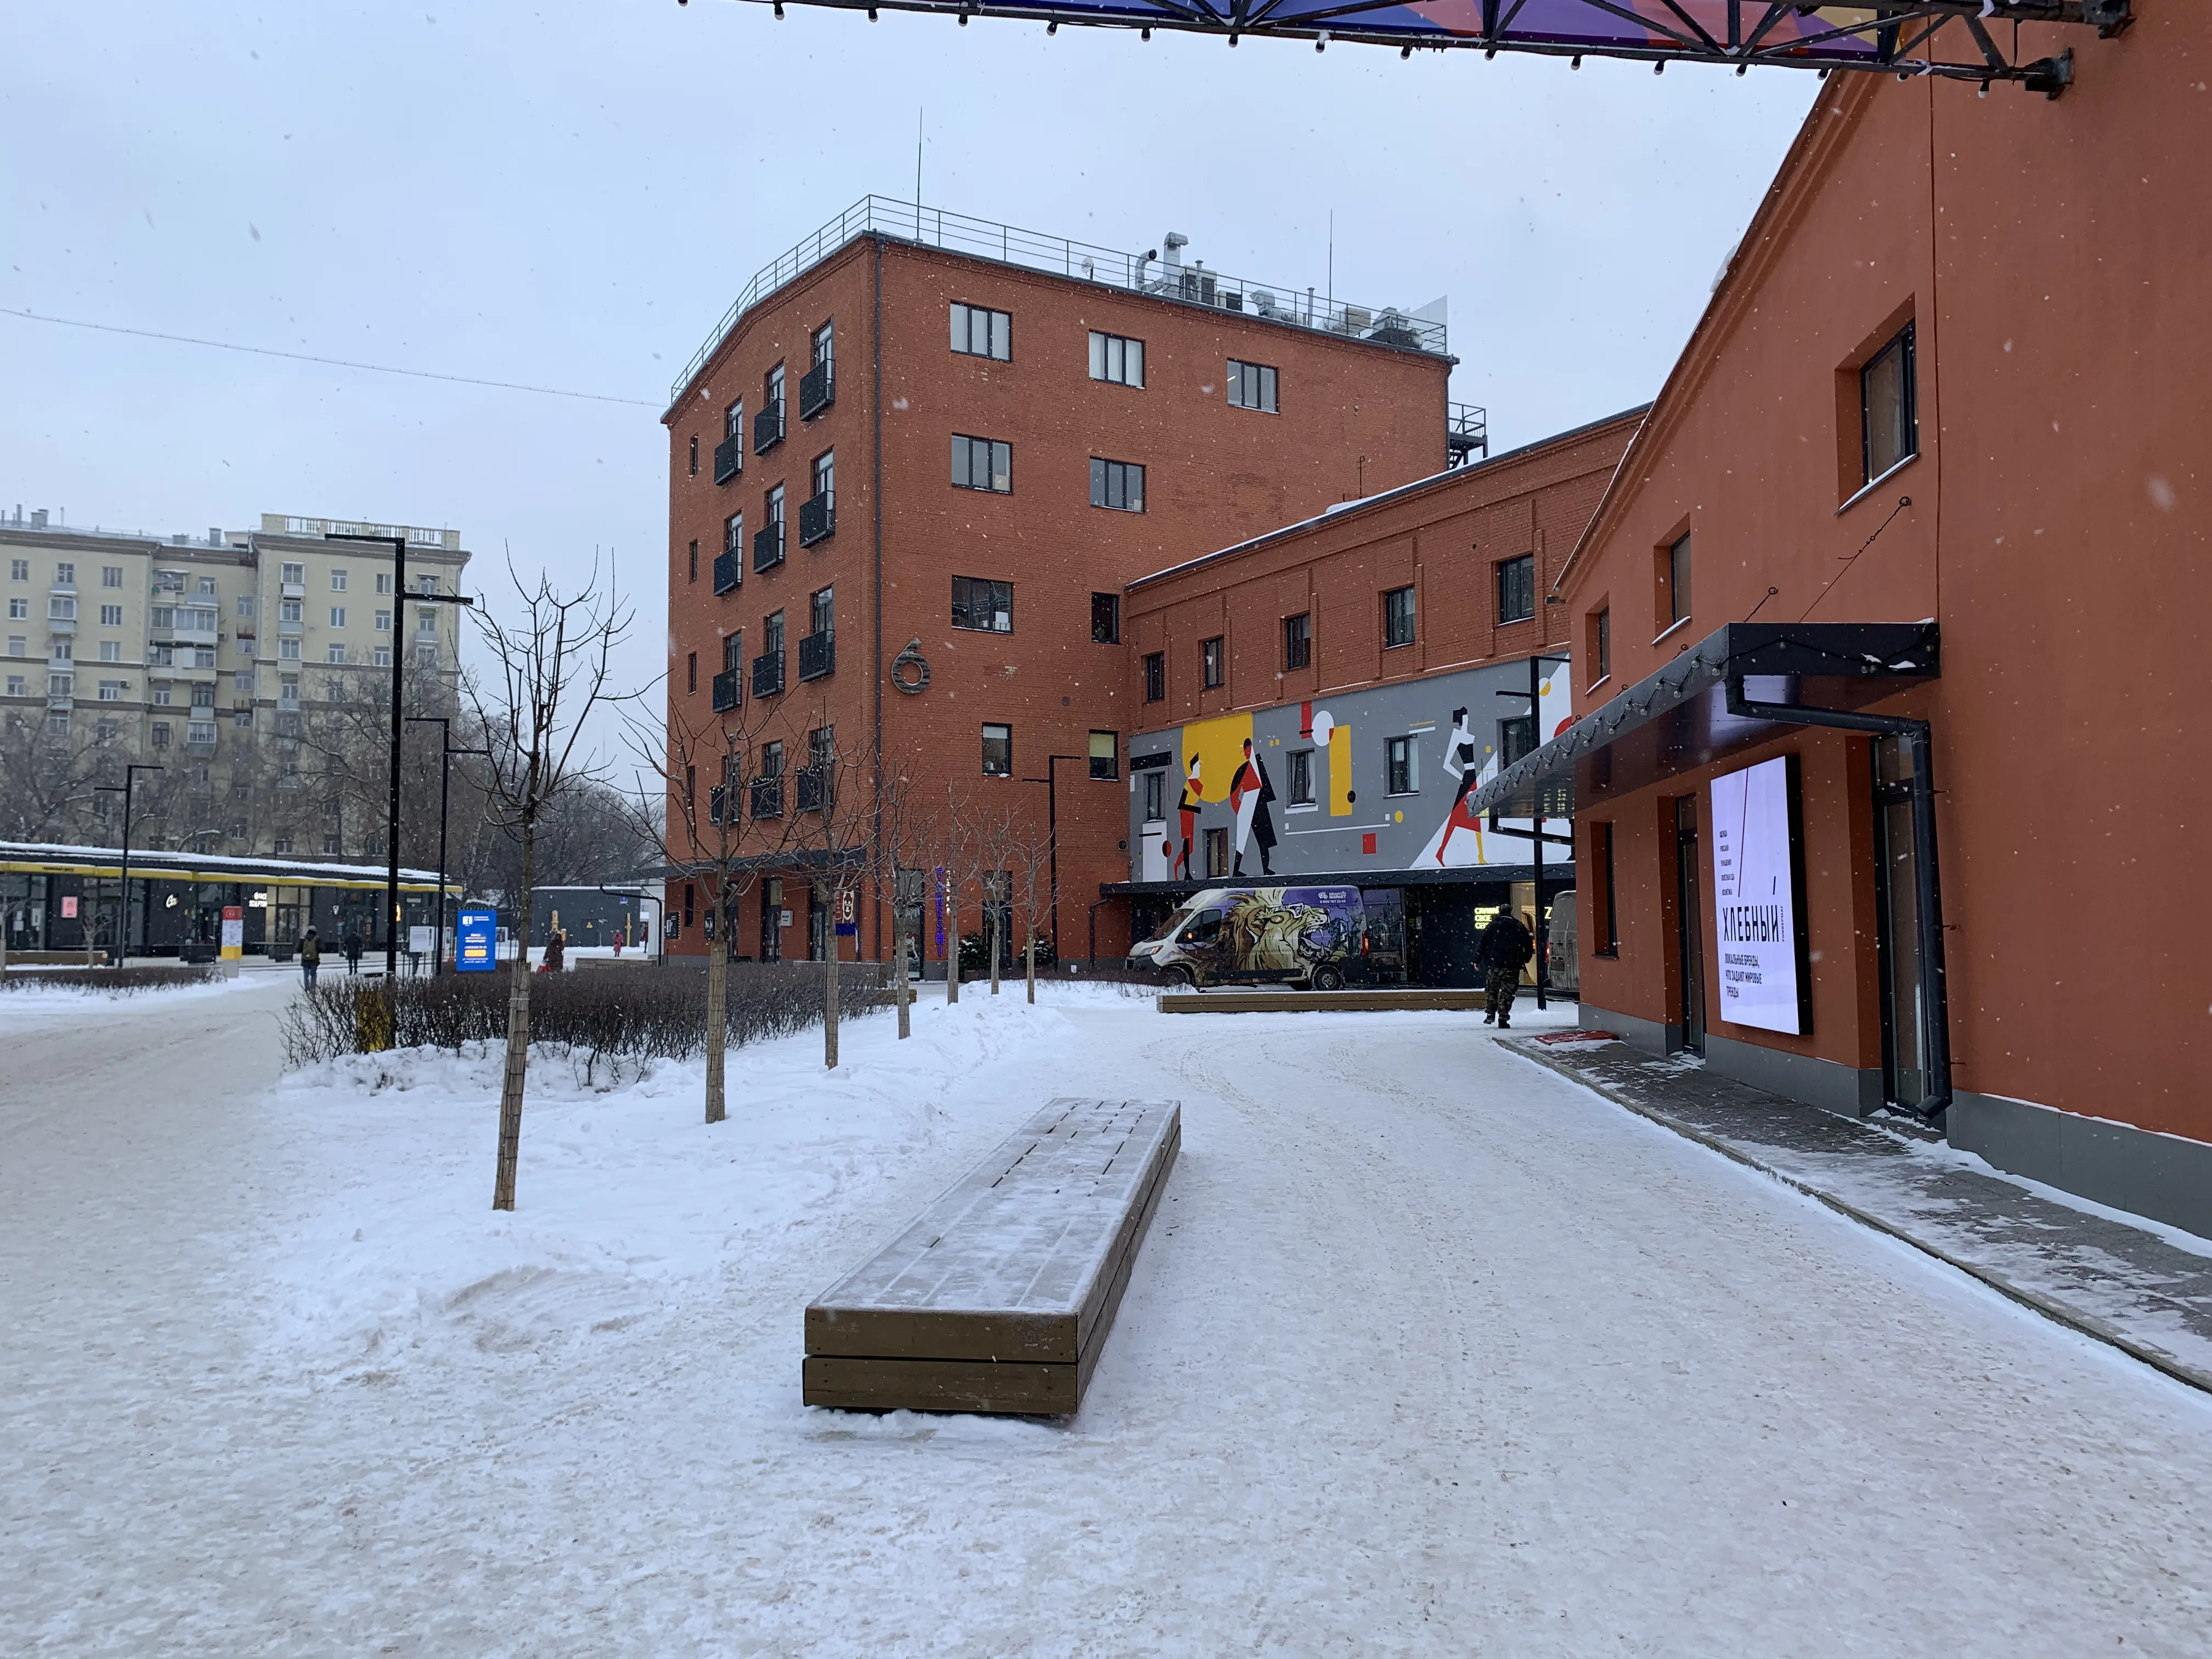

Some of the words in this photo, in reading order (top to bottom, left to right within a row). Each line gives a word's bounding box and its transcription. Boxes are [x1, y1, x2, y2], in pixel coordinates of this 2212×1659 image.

[891, 637, 930, 694] 6
[935, 868, 944, 956] TAKESHI
[1723, 905, 1779, 942] ХЛЕБНЫЙ
[1725, 953, 1743, 966] ЛОКАЛЬНЫЕ
[1731, 970, 1745, 983] ЗАДАЮТ
[1745, 972, 1762, 984] МИРОВЫЕ
[1726, 985, 1739, 999] ТРЕНДЫ
